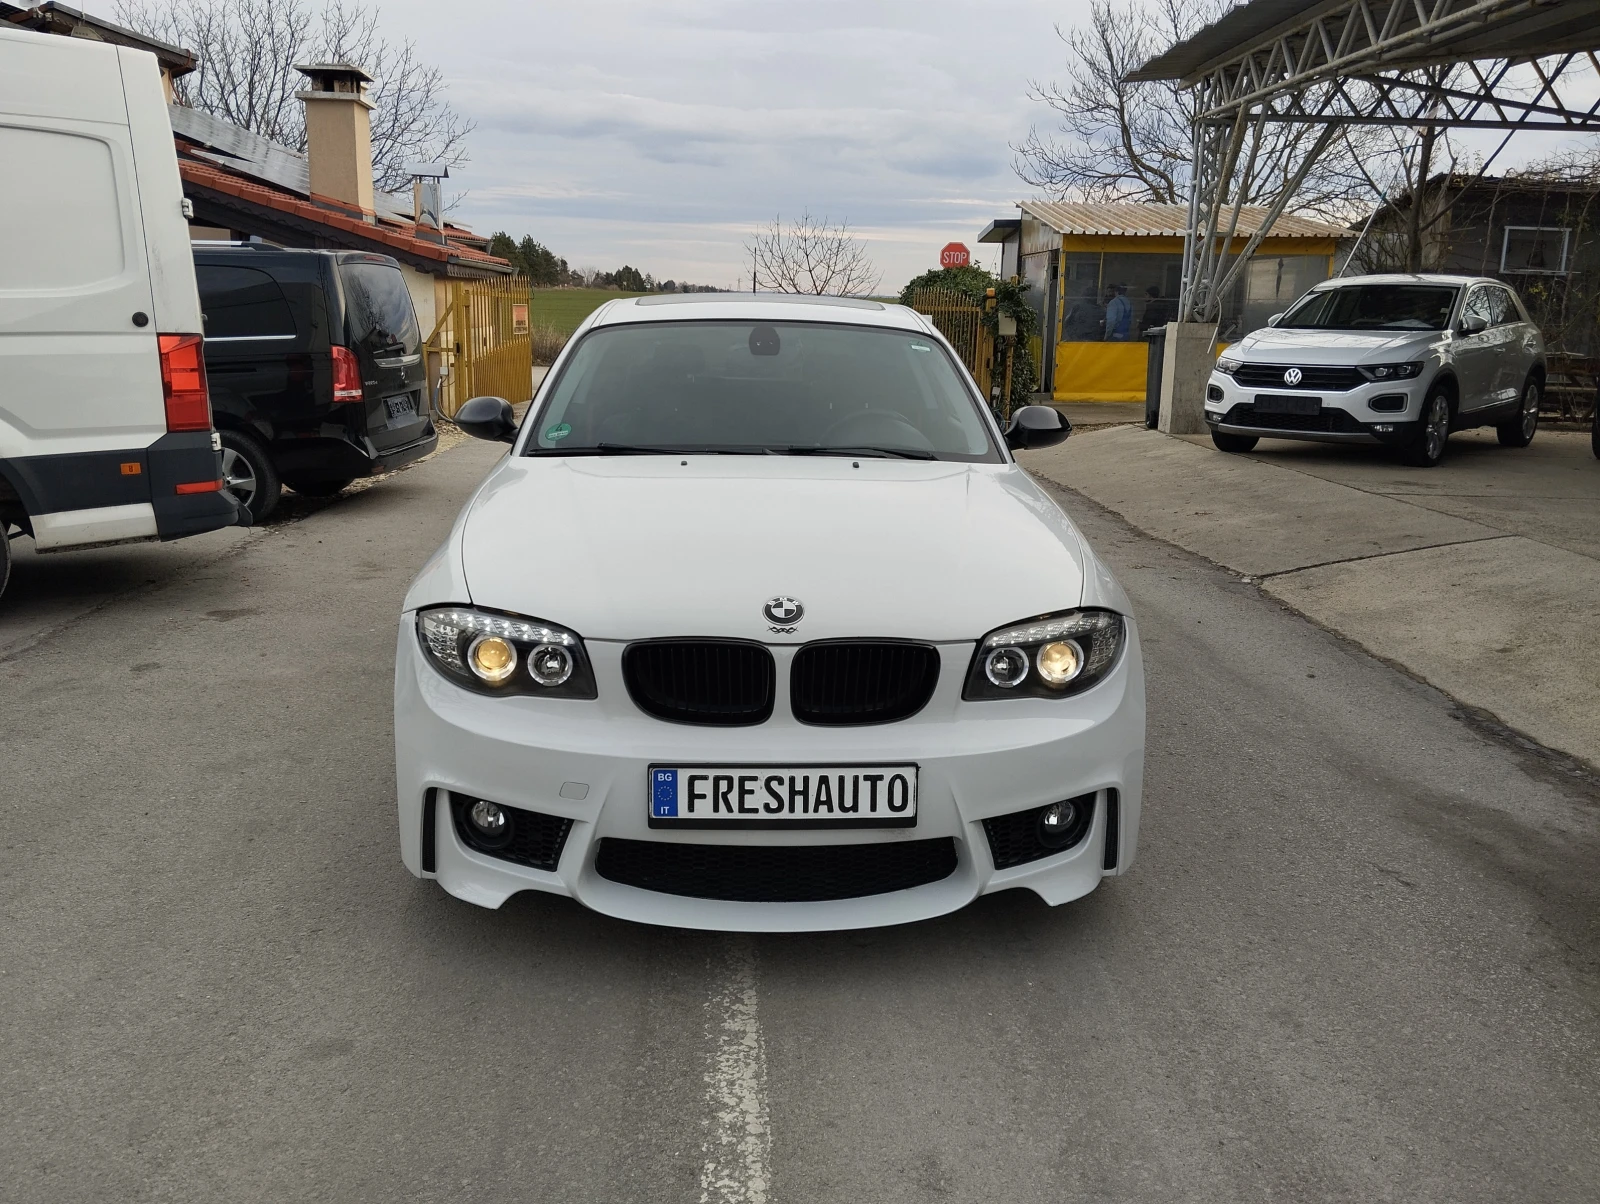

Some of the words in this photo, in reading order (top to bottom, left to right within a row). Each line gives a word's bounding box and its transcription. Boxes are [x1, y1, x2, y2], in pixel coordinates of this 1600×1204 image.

[943, 252, 967, 263] STOP
[1284, 368, 1302, 386] VW
[657, 773, 672, 782] BG
[687, 773, 909, 814] FRESHAUTO
[660, 807, 670, 815] IT
